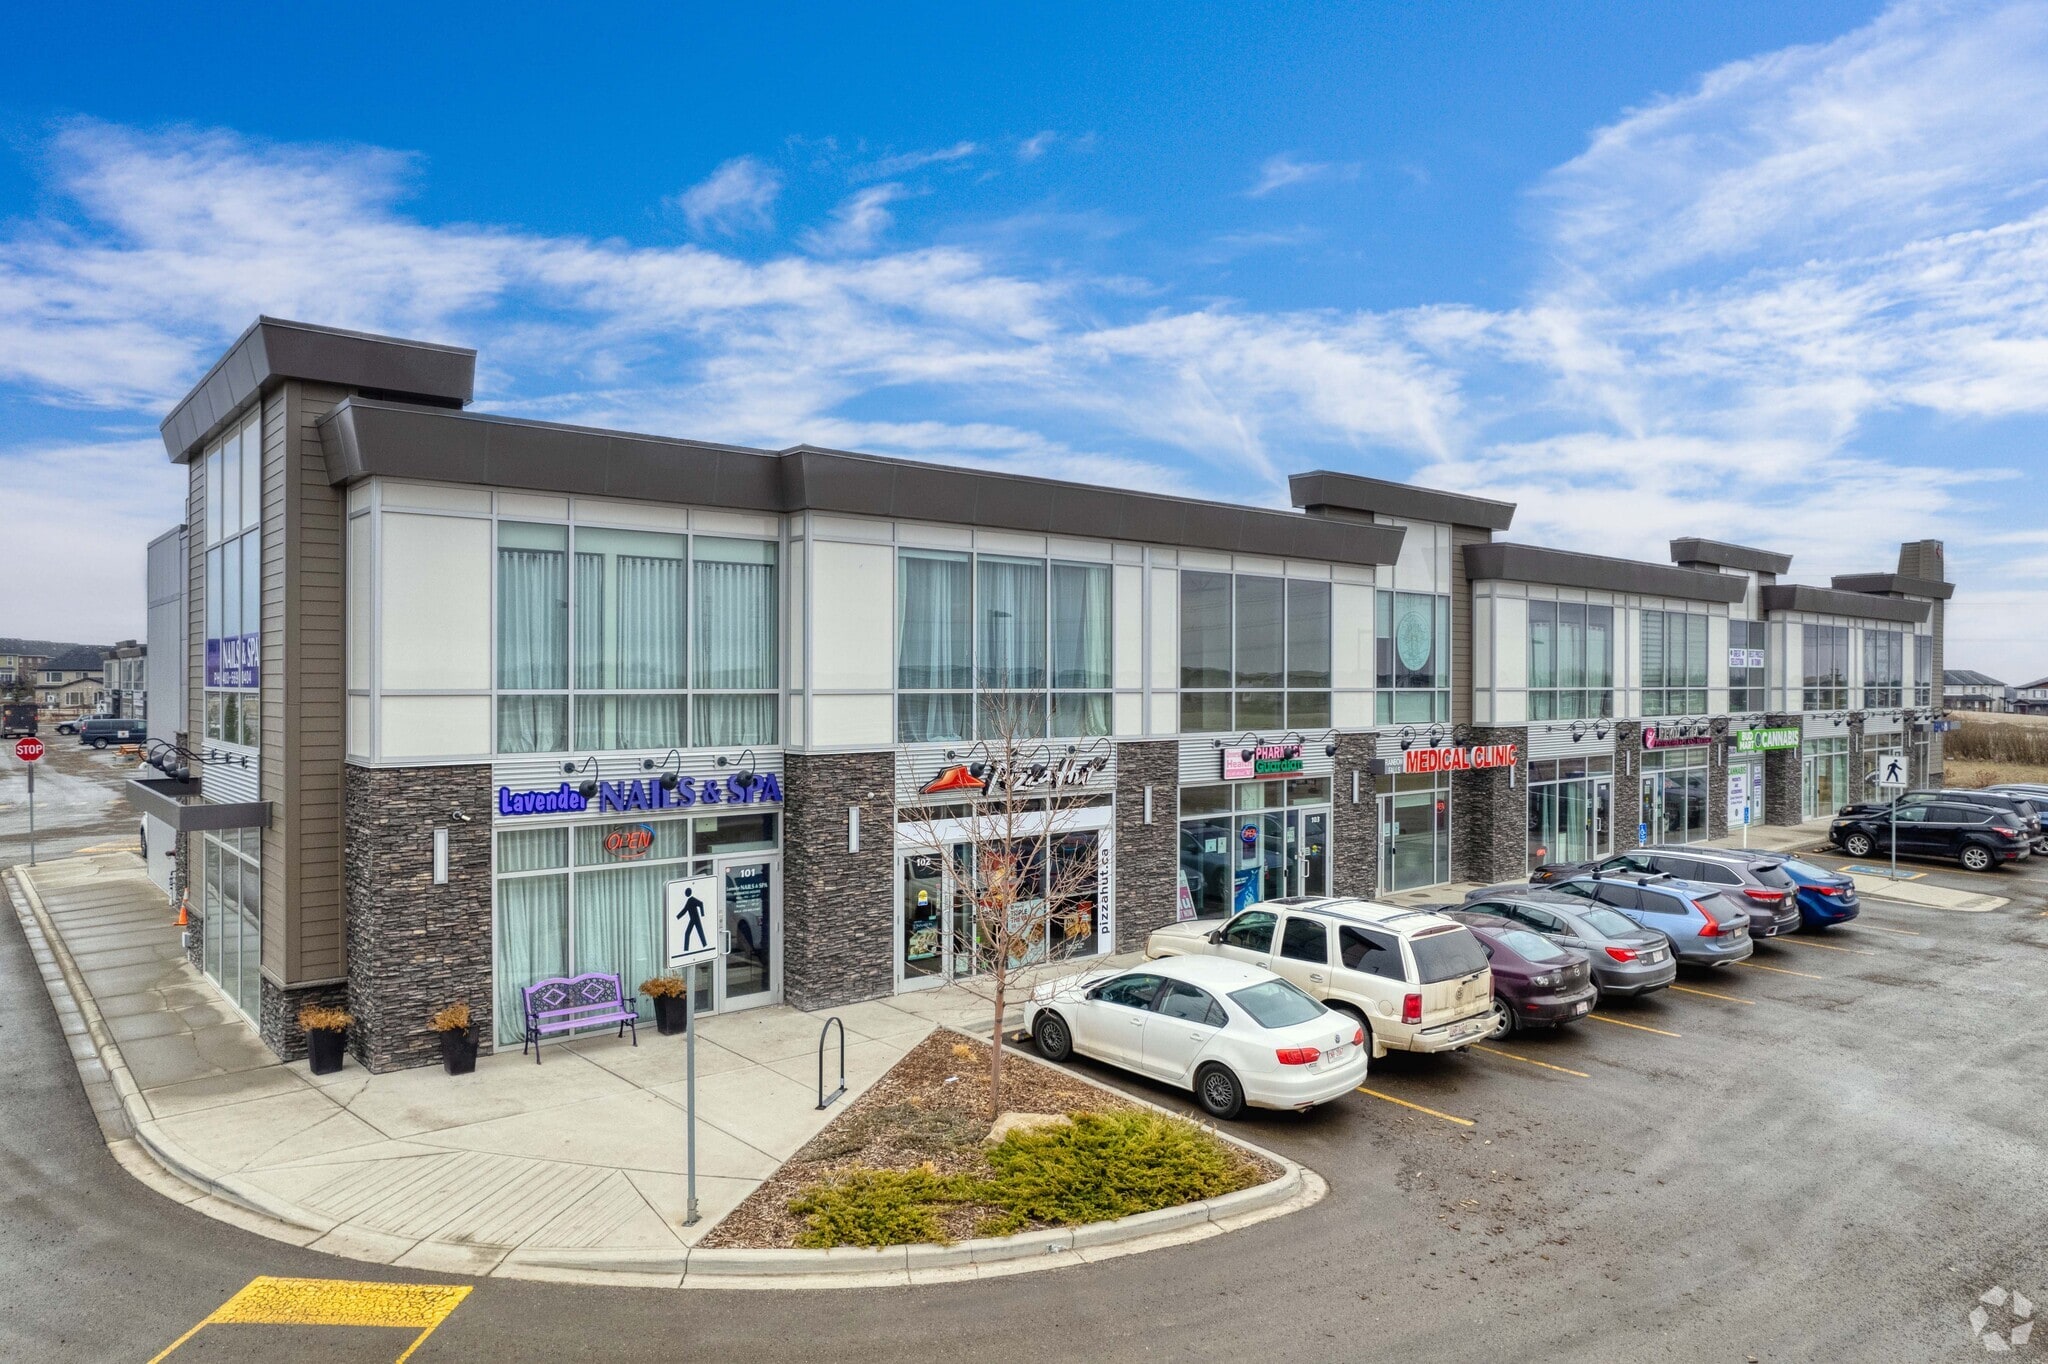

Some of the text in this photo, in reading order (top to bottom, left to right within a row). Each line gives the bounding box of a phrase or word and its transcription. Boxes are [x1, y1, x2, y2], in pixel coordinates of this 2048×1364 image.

[223, 640, 240, 669] NAILS
[247, 637, 259, 668] SPA
[1740, 740, 1754, 750] MART
[1741, 730, 1799, 748] BUD CANNABIS
[16, 745, 43, 755] STOP
[1256, 745, 1304, 760] PHARMCY
[1405, 743, 1518, 774] MEDICAL CLINIC
[1256, 760, 1304, 773] Guardian
[984, 759, 1054, 796] Pzza
[498, 772, 783, 816] Lavender NAILS & SPA
[606, 831, 651, 851] OPEN
[917, 858, 931, 867] 102
[740, 869, 755, 878] 101
[1100, 848, 1110, 935] pizzahut.ca
